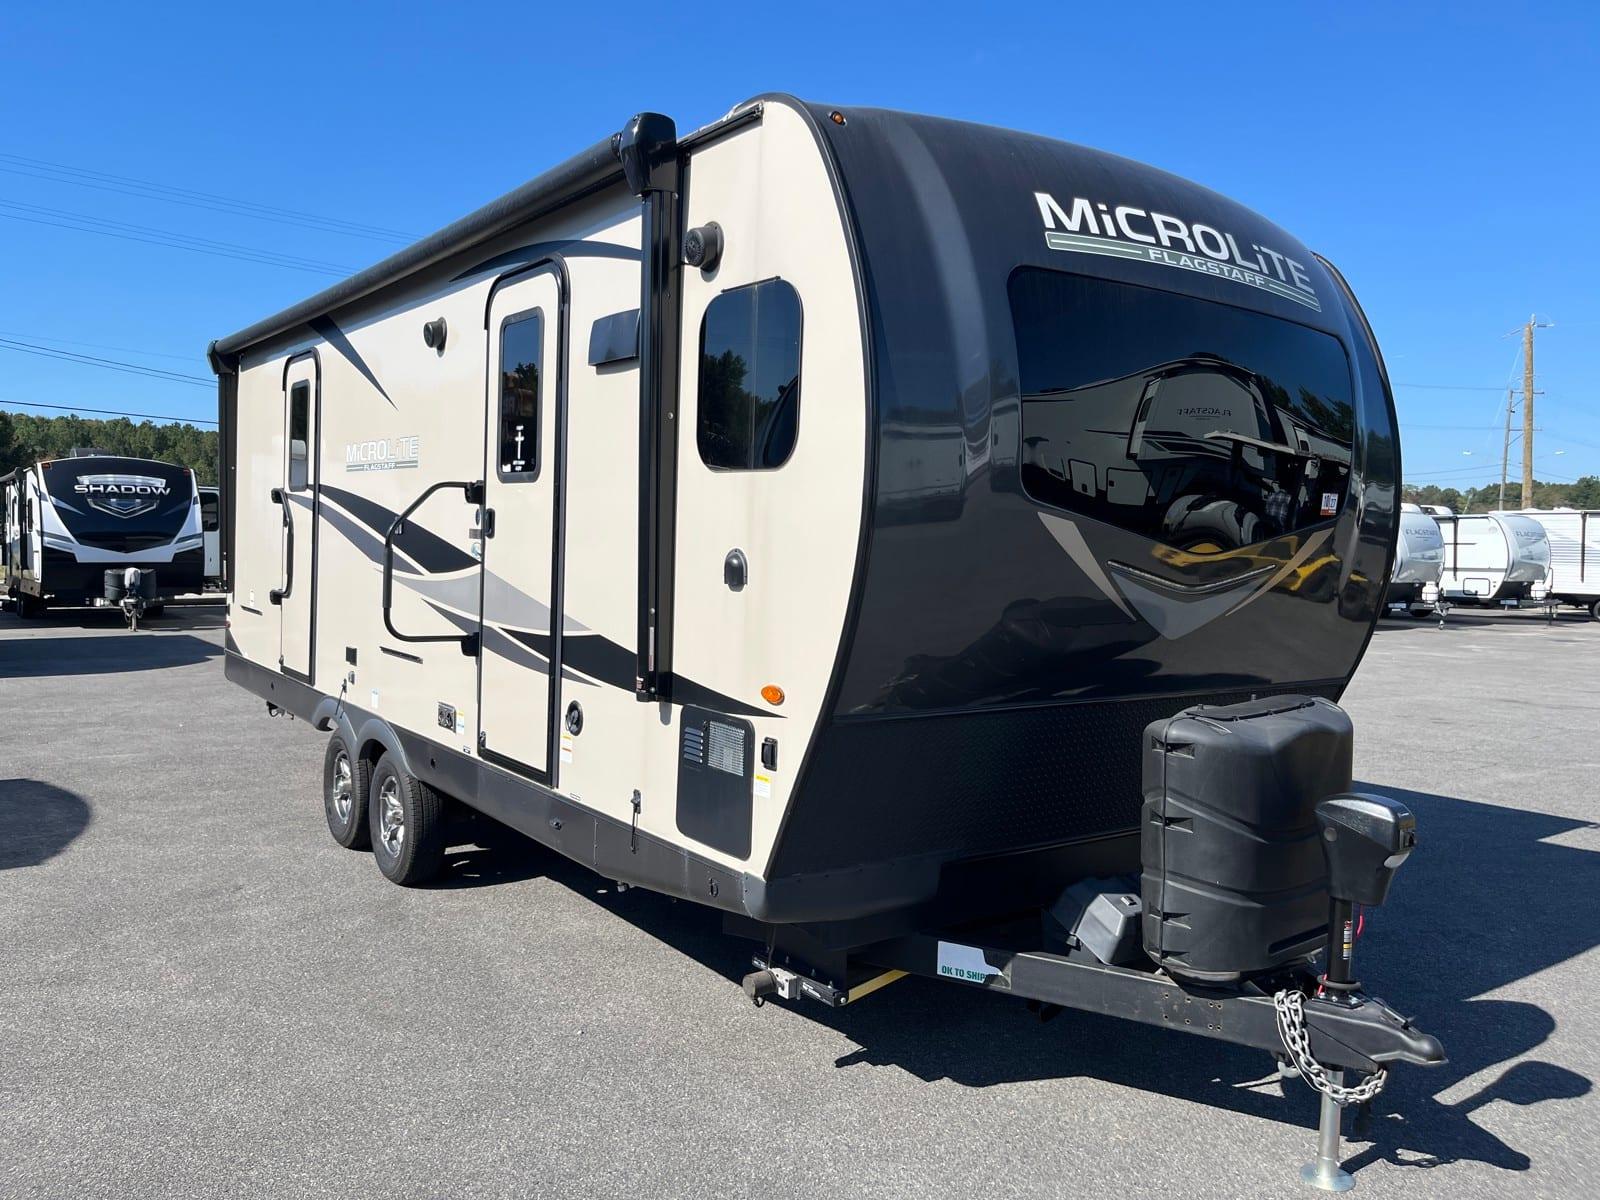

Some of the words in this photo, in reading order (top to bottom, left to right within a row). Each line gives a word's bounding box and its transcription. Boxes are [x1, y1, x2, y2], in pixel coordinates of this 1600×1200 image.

[1148, 248, 1265, 287] FLAGSTAFF
[74, 484, 171, 495] SHADOW
[942, 966, 953, 975] OK
[954, 968, 965, 977] TO
[966, 970, 986, 981] SHIP
